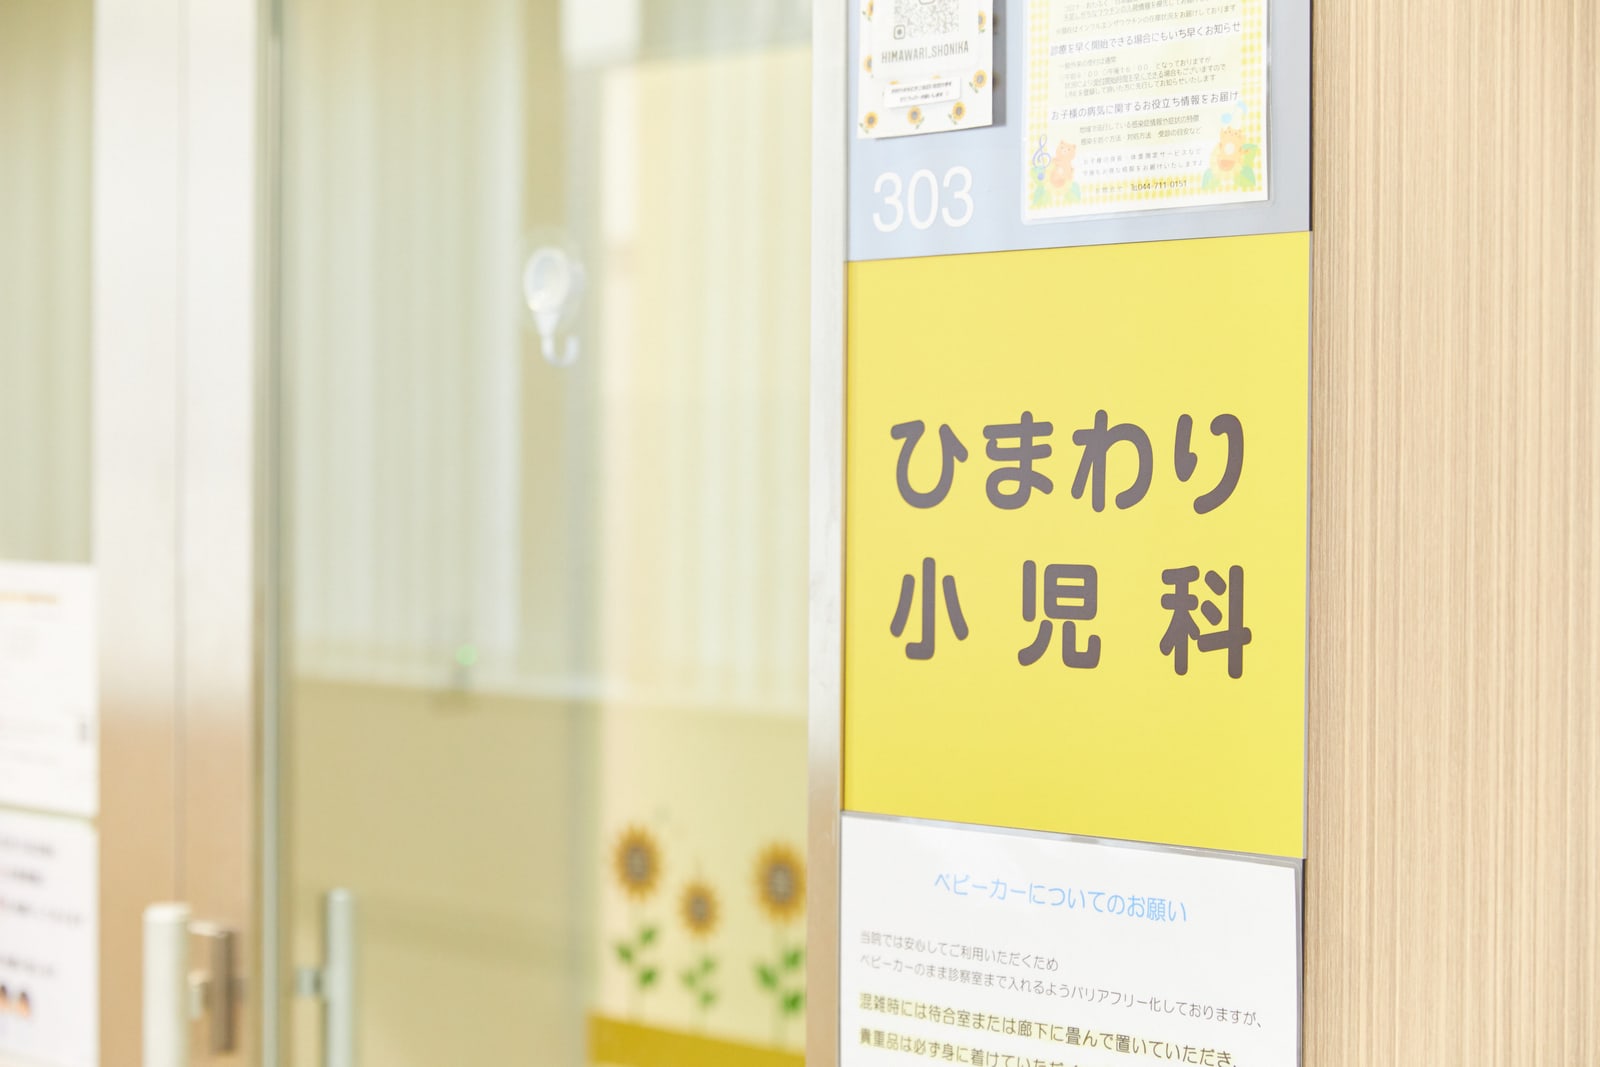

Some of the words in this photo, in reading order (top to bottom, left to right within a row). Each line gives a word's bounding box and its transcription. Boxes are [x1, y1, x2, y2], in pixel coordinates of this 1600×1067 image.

[1051, 21, 1240, 56] 診療を早く開始できる場合にもいち早くお知らせ
[1051, 91, 1238, 120] お子様の病気に関するお役立ち情報をお届け
[872, 165, 974, 233] 303
[890, 409, 1244, 514] ひまわり
[890, 557, 1252, 679] 小児科
[934, 872, 1188, 923] ベビーカーについてのお願い
[860, 930, 1059, 972] 当院では安心してご利用いただくため
[859, 1027, 1078, 1067] 貴重品は必ず身に着けていた
